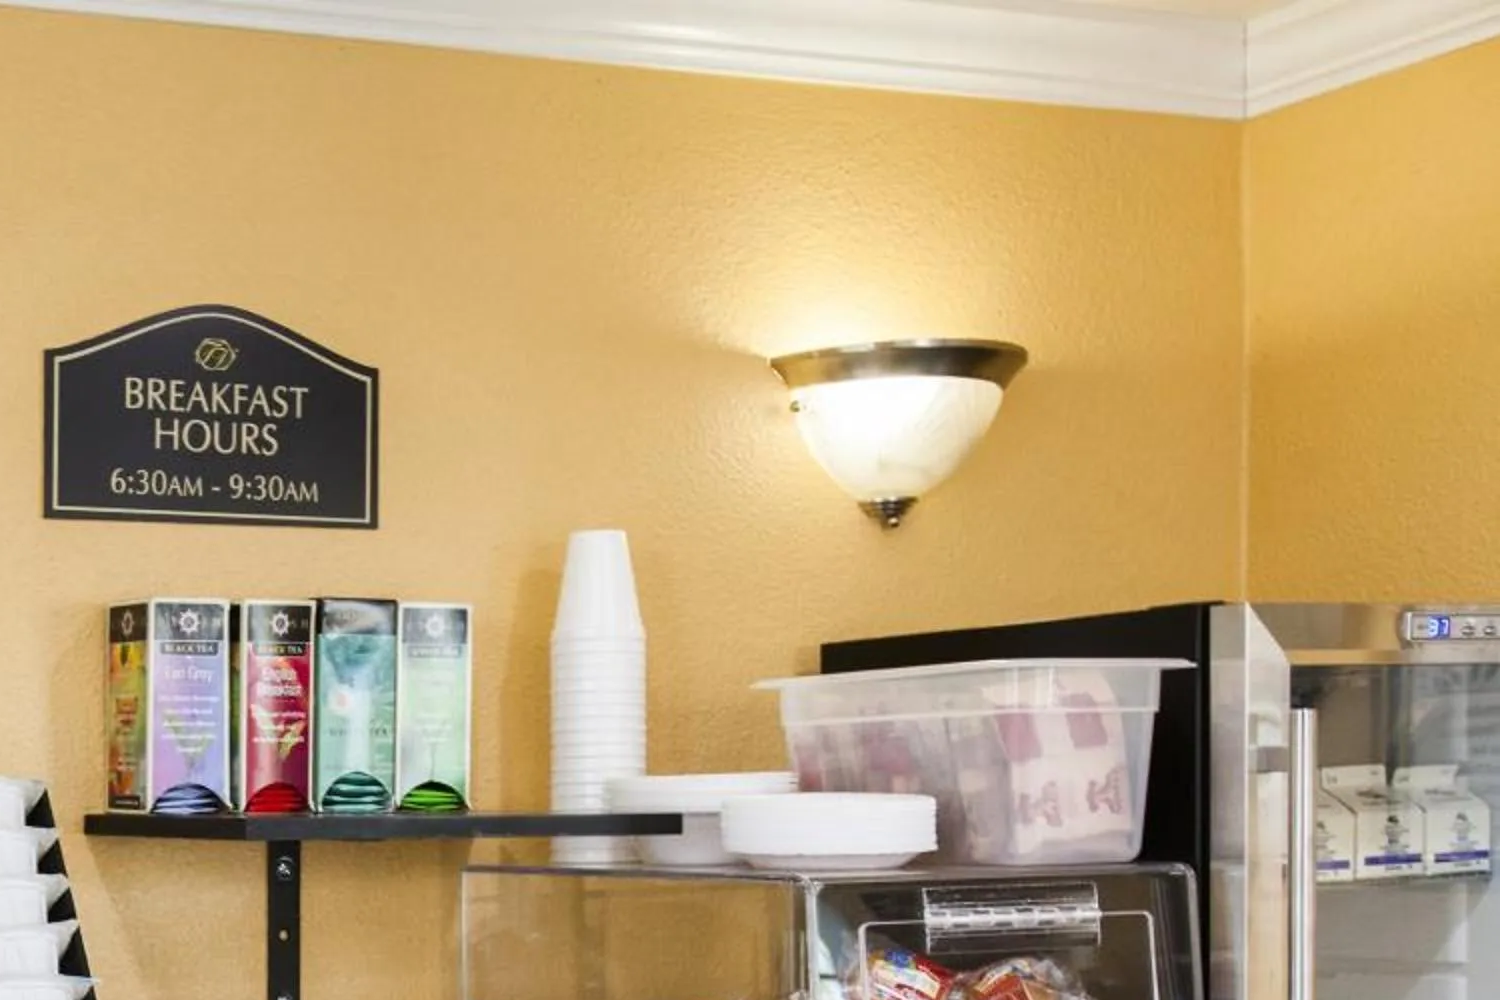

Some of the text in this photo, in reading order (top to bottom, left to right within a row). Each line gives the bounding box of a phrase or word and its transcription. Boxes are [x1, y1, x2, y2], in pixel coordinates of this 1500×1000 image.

[124, 376, 309, 420] BREAKFAST
[154, 417, 280, 457] HOURS
[110, 467, 204, 498] 6:30AM
[228, 473, 320, 503] 9:30AM
